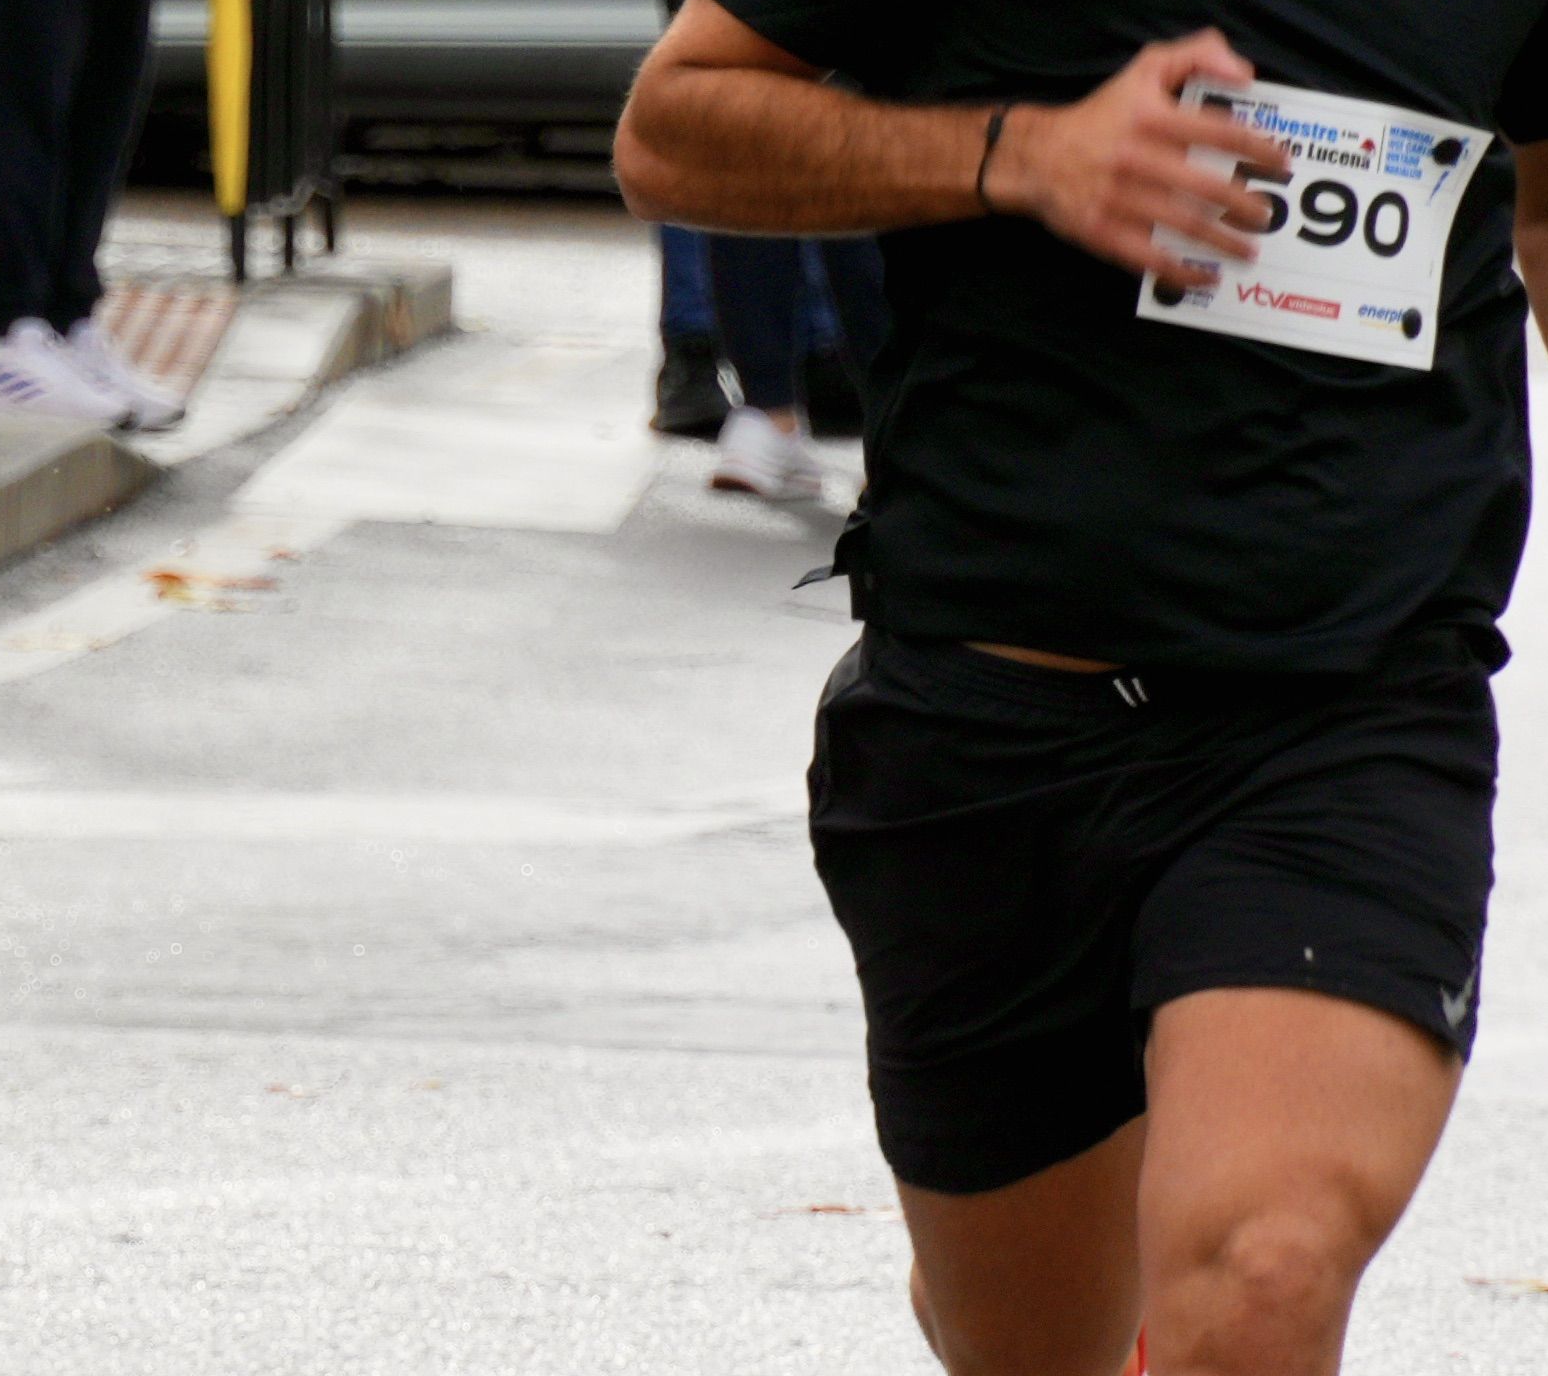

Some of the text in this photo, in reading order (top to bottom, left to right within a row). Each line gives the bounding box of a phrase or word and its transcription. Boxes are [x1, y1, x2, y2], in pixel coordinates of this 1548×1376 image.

[1254, 107, 1339, 144] Silvestre
[1306, 143, 1372, 171] Lucena
[1357, 302, 1404, 325] enerpl
